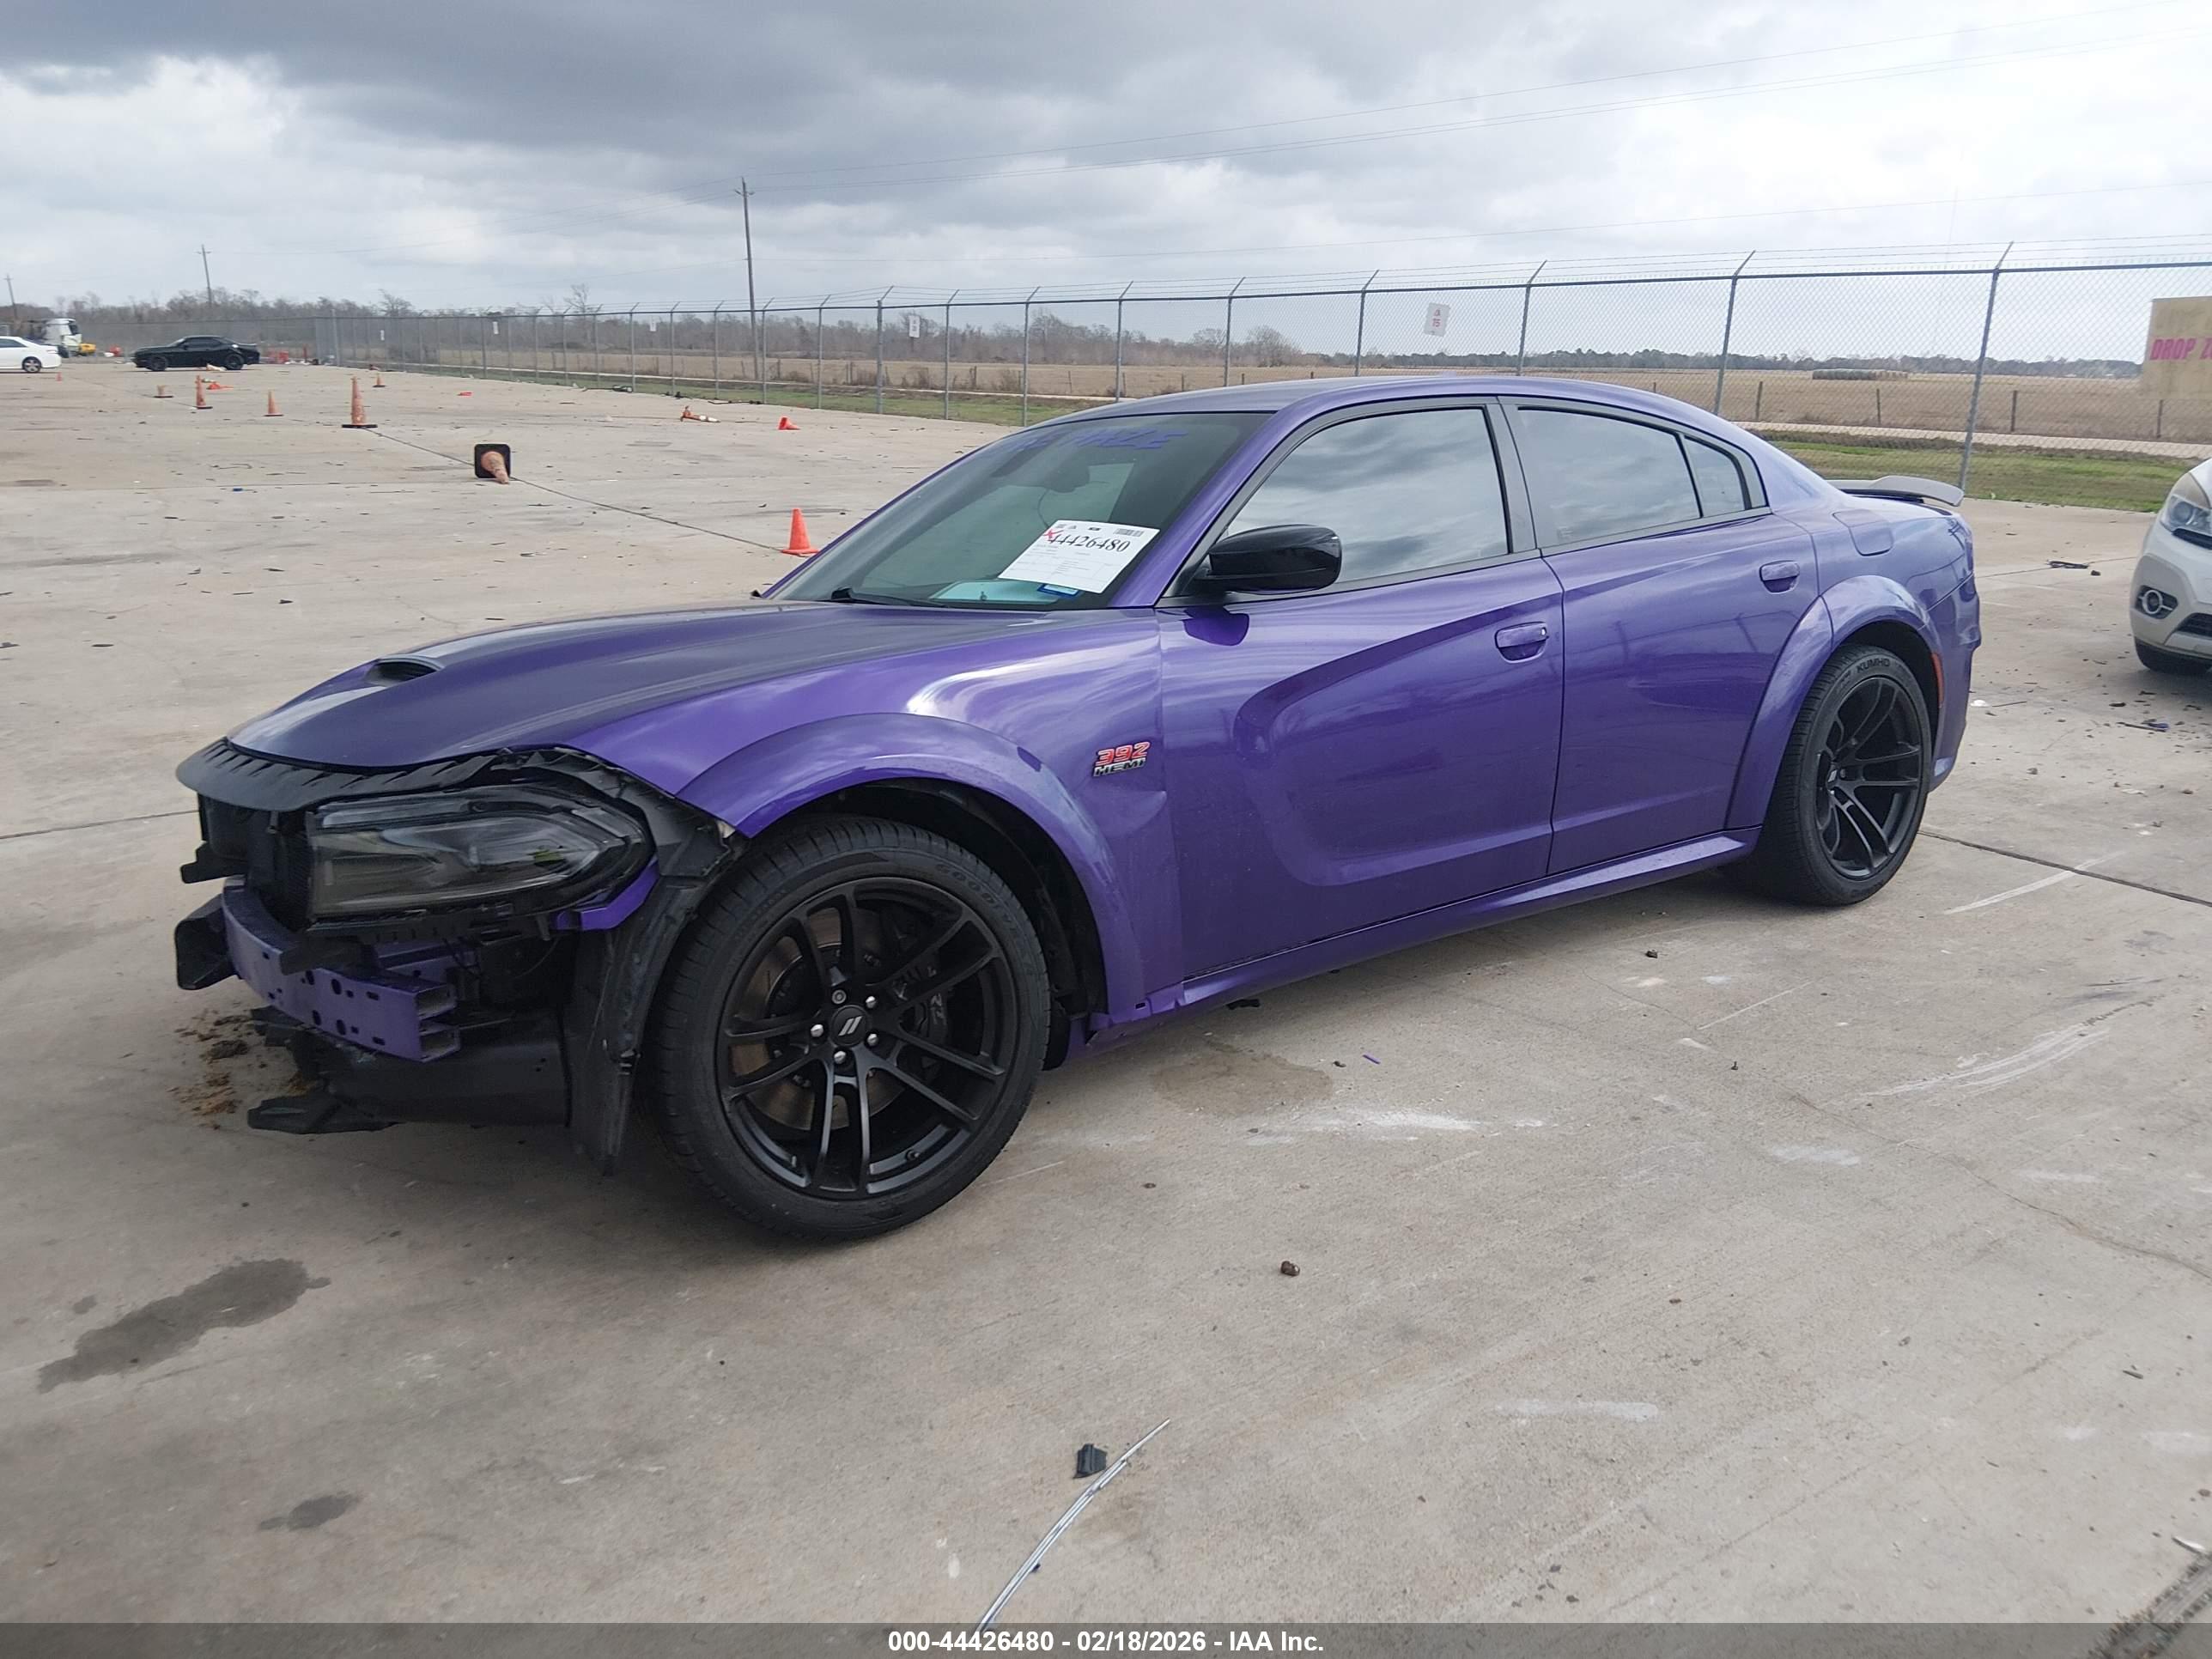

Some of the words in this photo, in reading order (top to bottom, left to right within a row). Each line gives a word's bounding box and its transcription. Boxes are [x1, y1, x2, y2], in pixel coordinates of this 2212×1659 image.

[2149, 337, 2196, 360] DROP
[1048, 533, 1131, 552] 44426480
[1095, 741, 1151, 766] 392
[1093, 757, 1146, 777] HEMI
